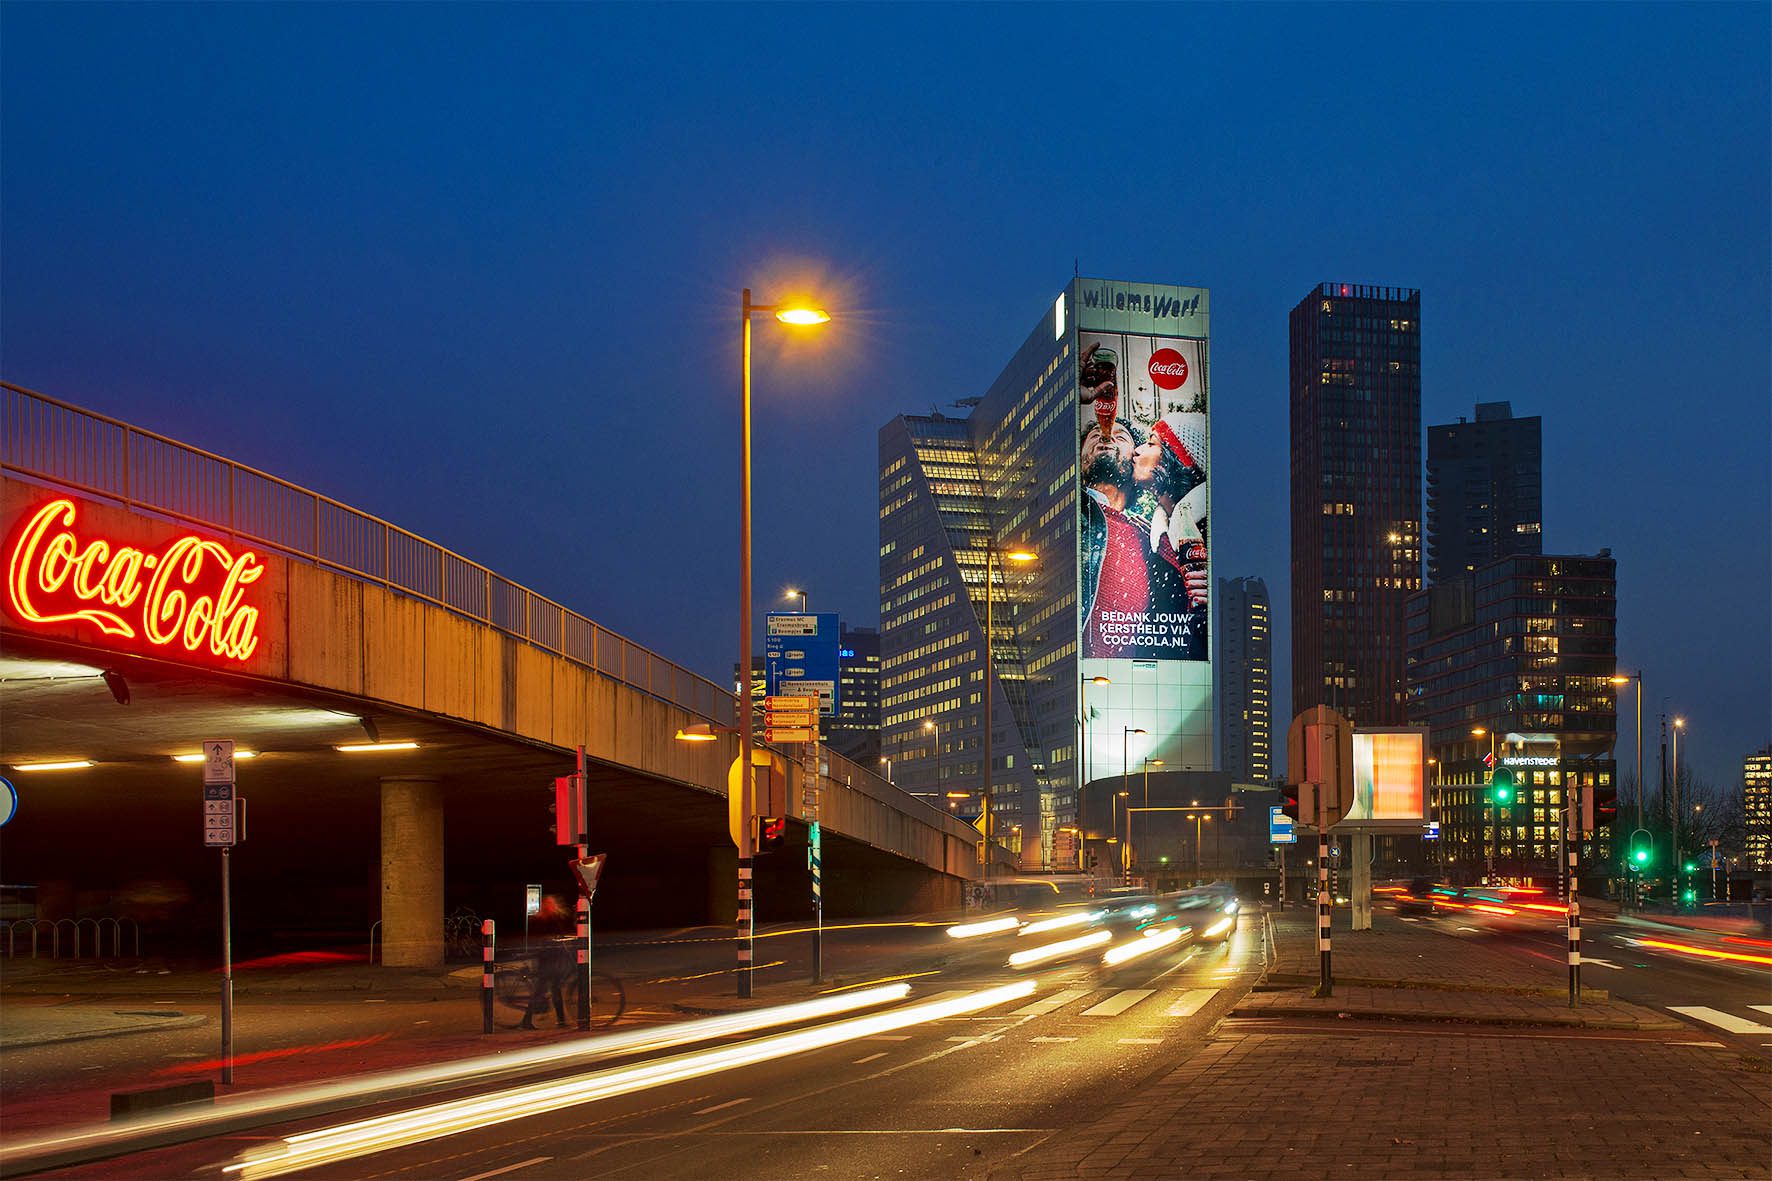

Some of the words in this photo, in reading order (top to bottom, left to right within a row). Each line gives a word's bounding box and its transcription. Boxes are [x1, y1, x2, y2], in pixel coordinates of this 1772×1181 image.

[1101, 611, 1151, 622] BEDANK
[1153, 613, 1189, 623] JOUW
[1099, 623, 1168, 634] KERSTHELD
[1170, 625, 1191, 635] VIA
[1103, 635, 1188, 647] COCACOLA.NL
